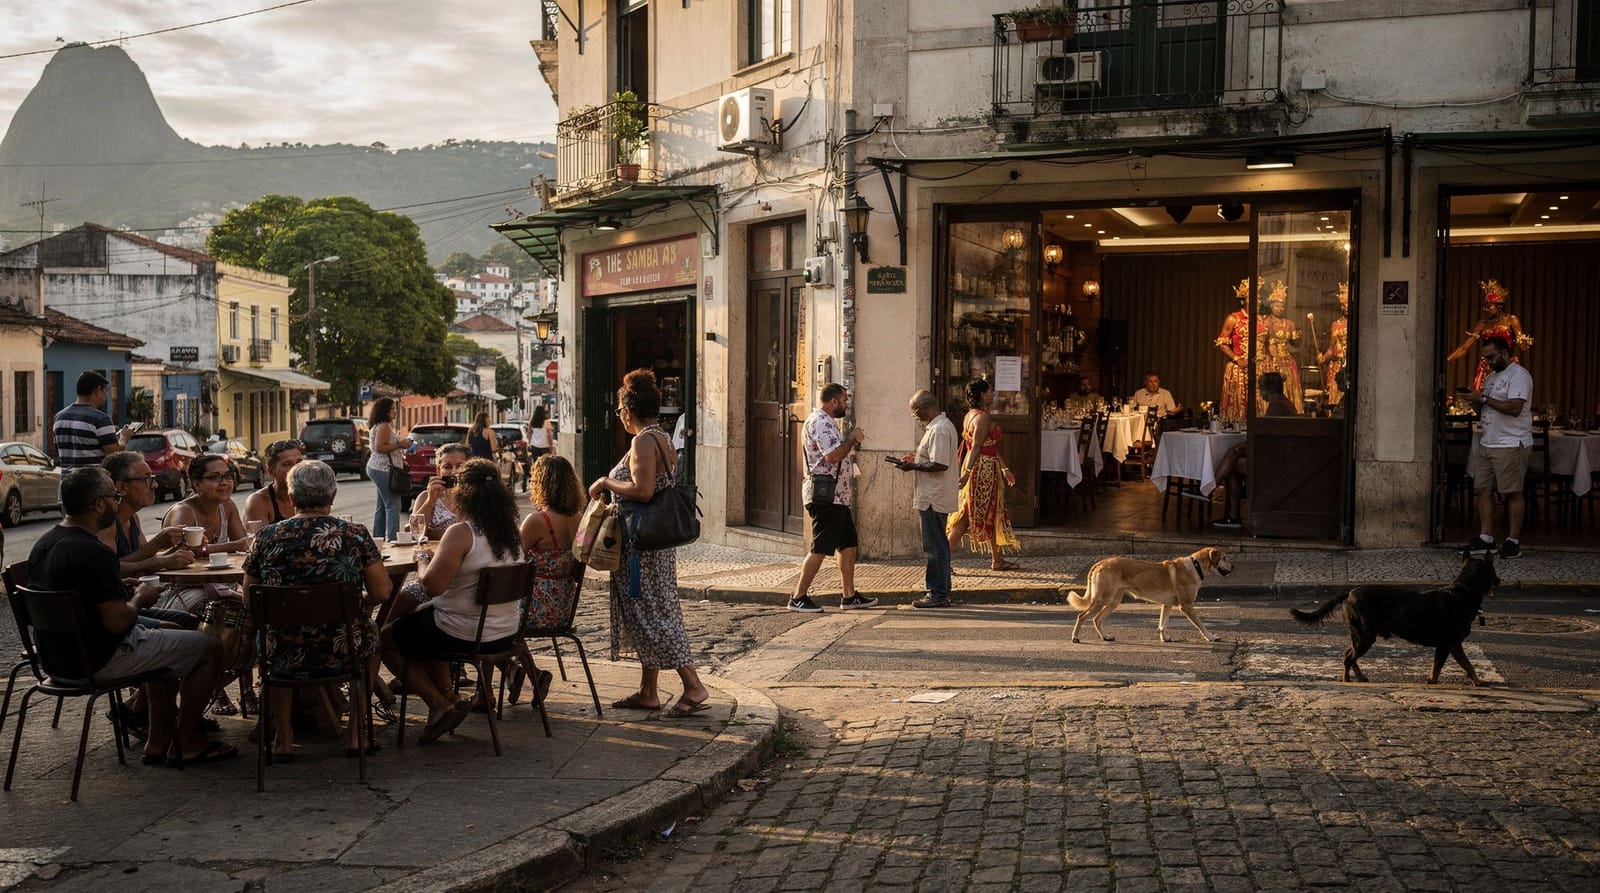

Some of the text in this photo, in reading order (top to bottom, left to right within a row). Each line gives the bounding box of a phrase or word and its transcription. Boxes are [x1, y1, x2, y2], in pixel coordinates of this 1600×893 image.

[606, 253, 622, 273] THE
[626, 247, 659, 270] SAMBA
[360, 385, 370, 396] P
